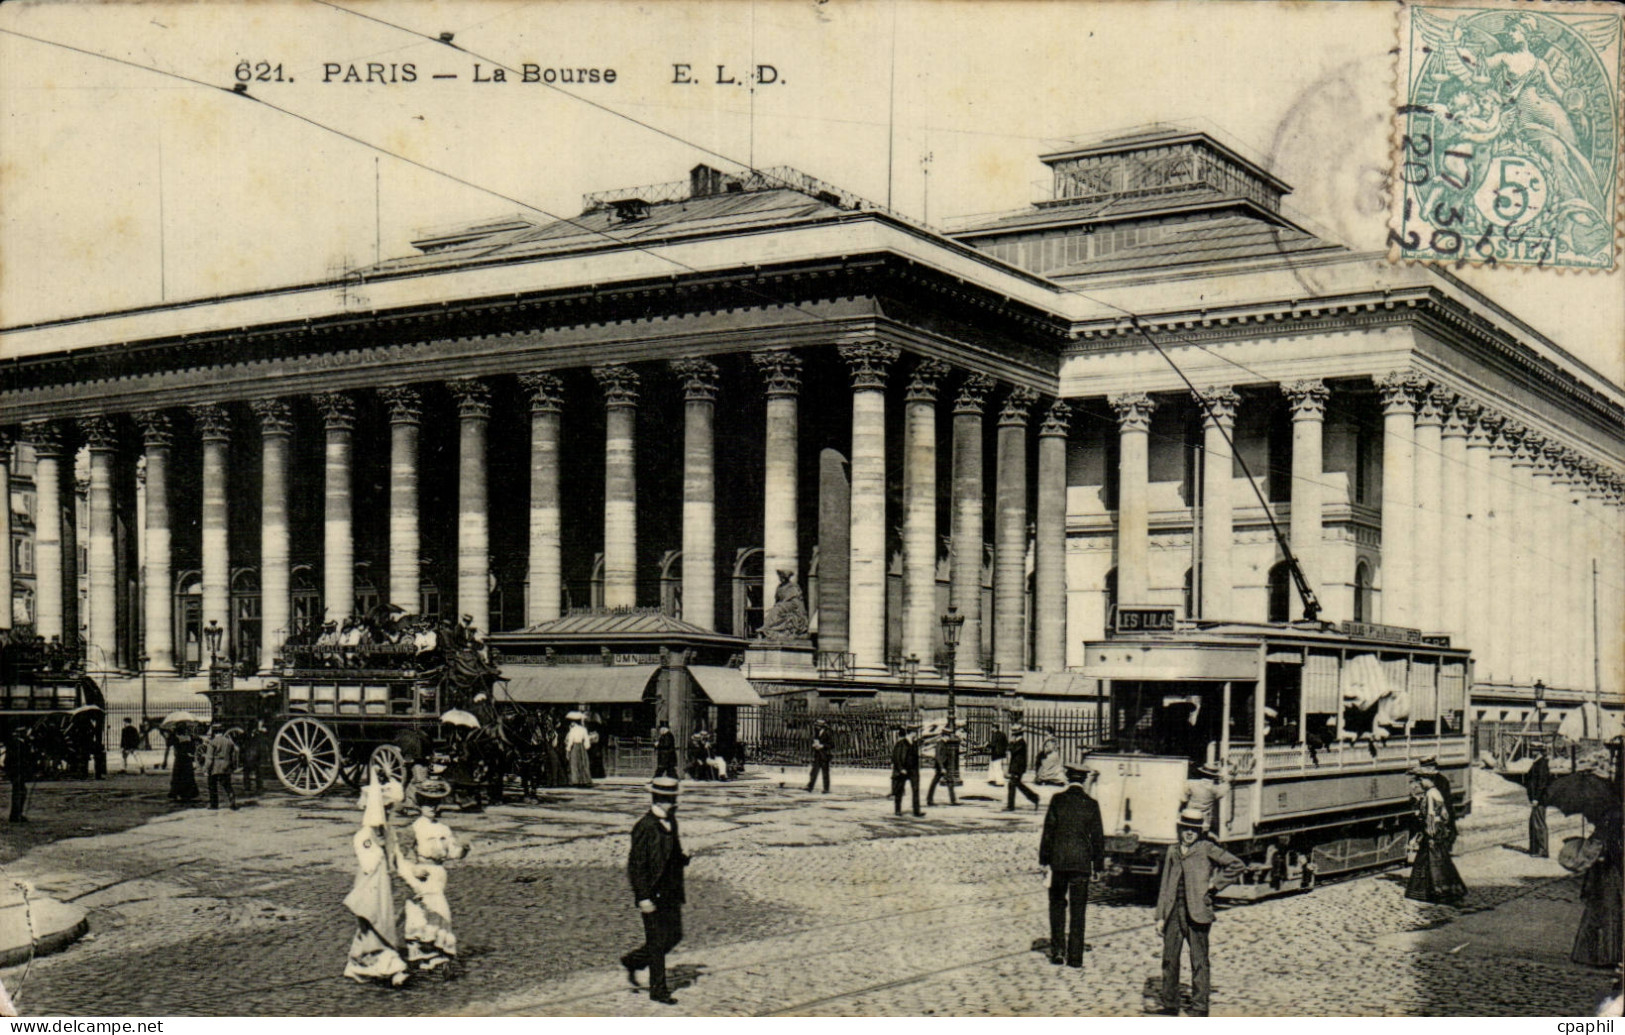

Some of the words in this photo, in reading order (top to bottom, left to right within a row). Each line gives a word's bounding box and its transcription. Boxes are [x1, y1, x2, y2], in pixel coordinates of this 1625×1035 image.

[1463, 238, 1554, 261] POSTES
[1118, 613, 1139, 629] LES
[1143, 613, 1174, 629] LILAS
